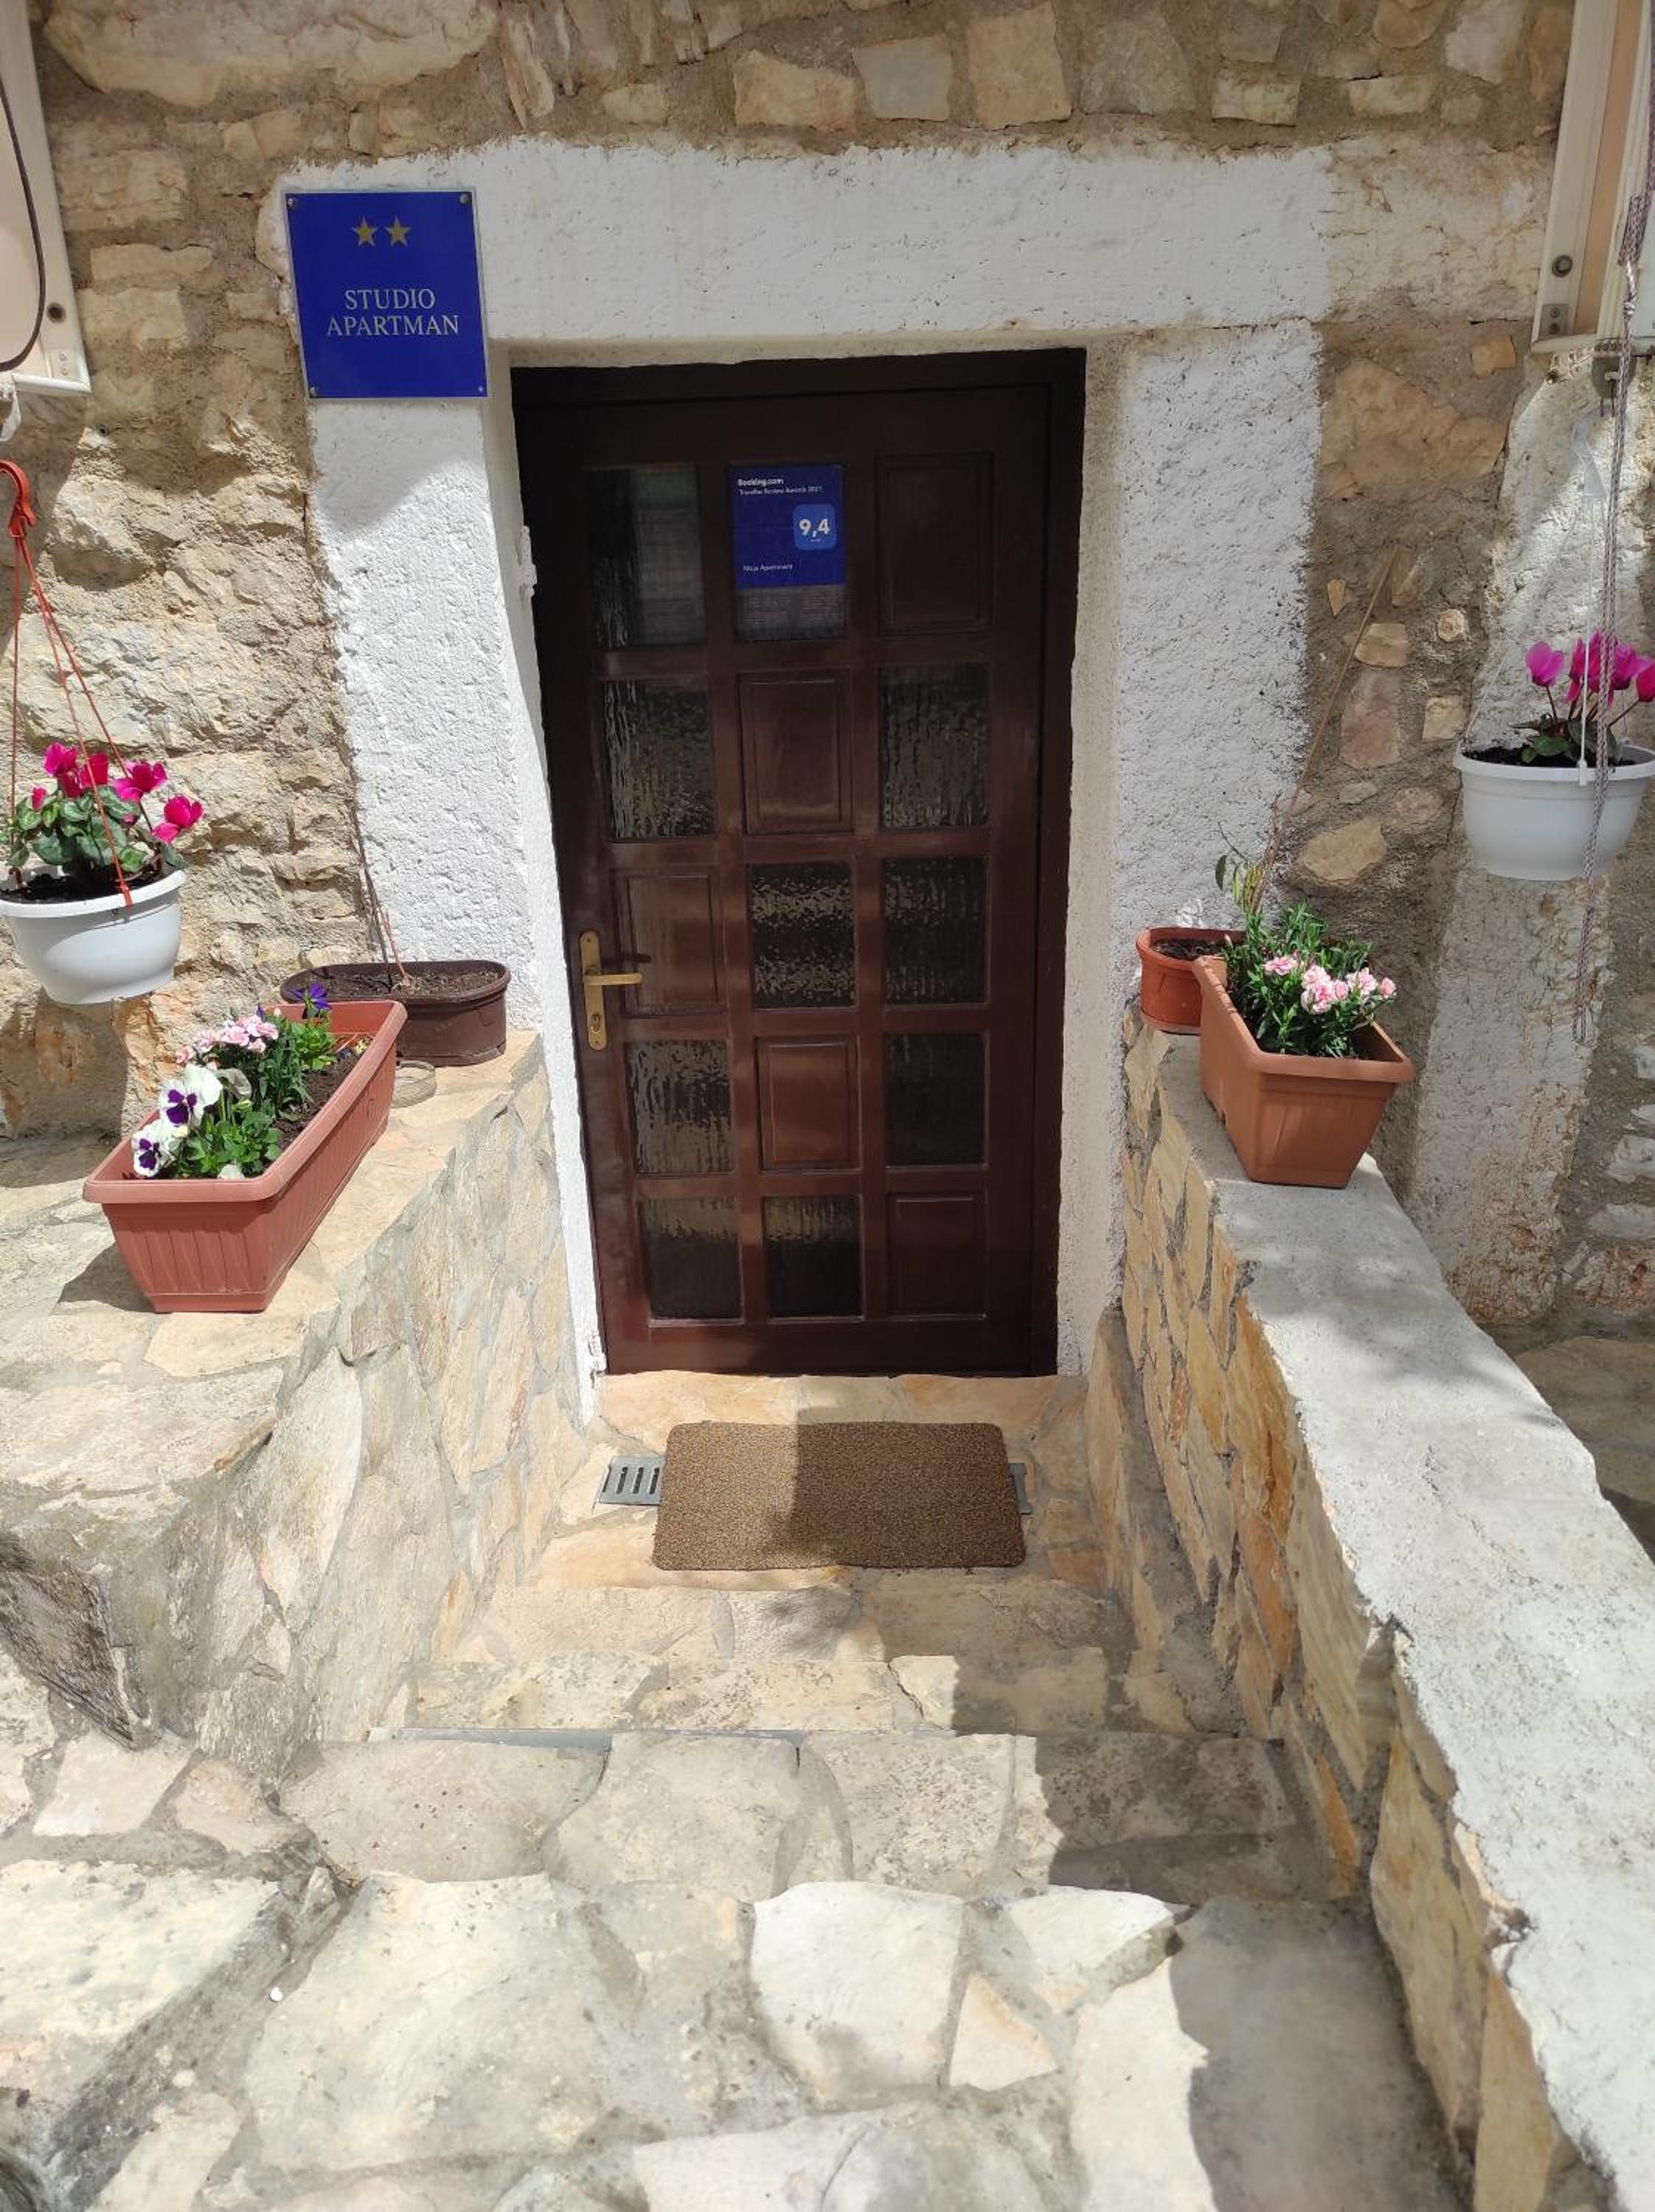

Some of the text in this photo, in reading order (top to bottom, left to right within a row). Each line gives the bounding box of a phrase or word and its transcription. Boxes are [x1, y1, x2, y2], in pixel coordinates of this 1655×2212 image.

[344, 288, 437, 310] STUDIO
[327, 316, 459, 337] APARTMAN
[738, 478, 784, 487] Booking.com
[799, 518, 830, 538] 9,4
